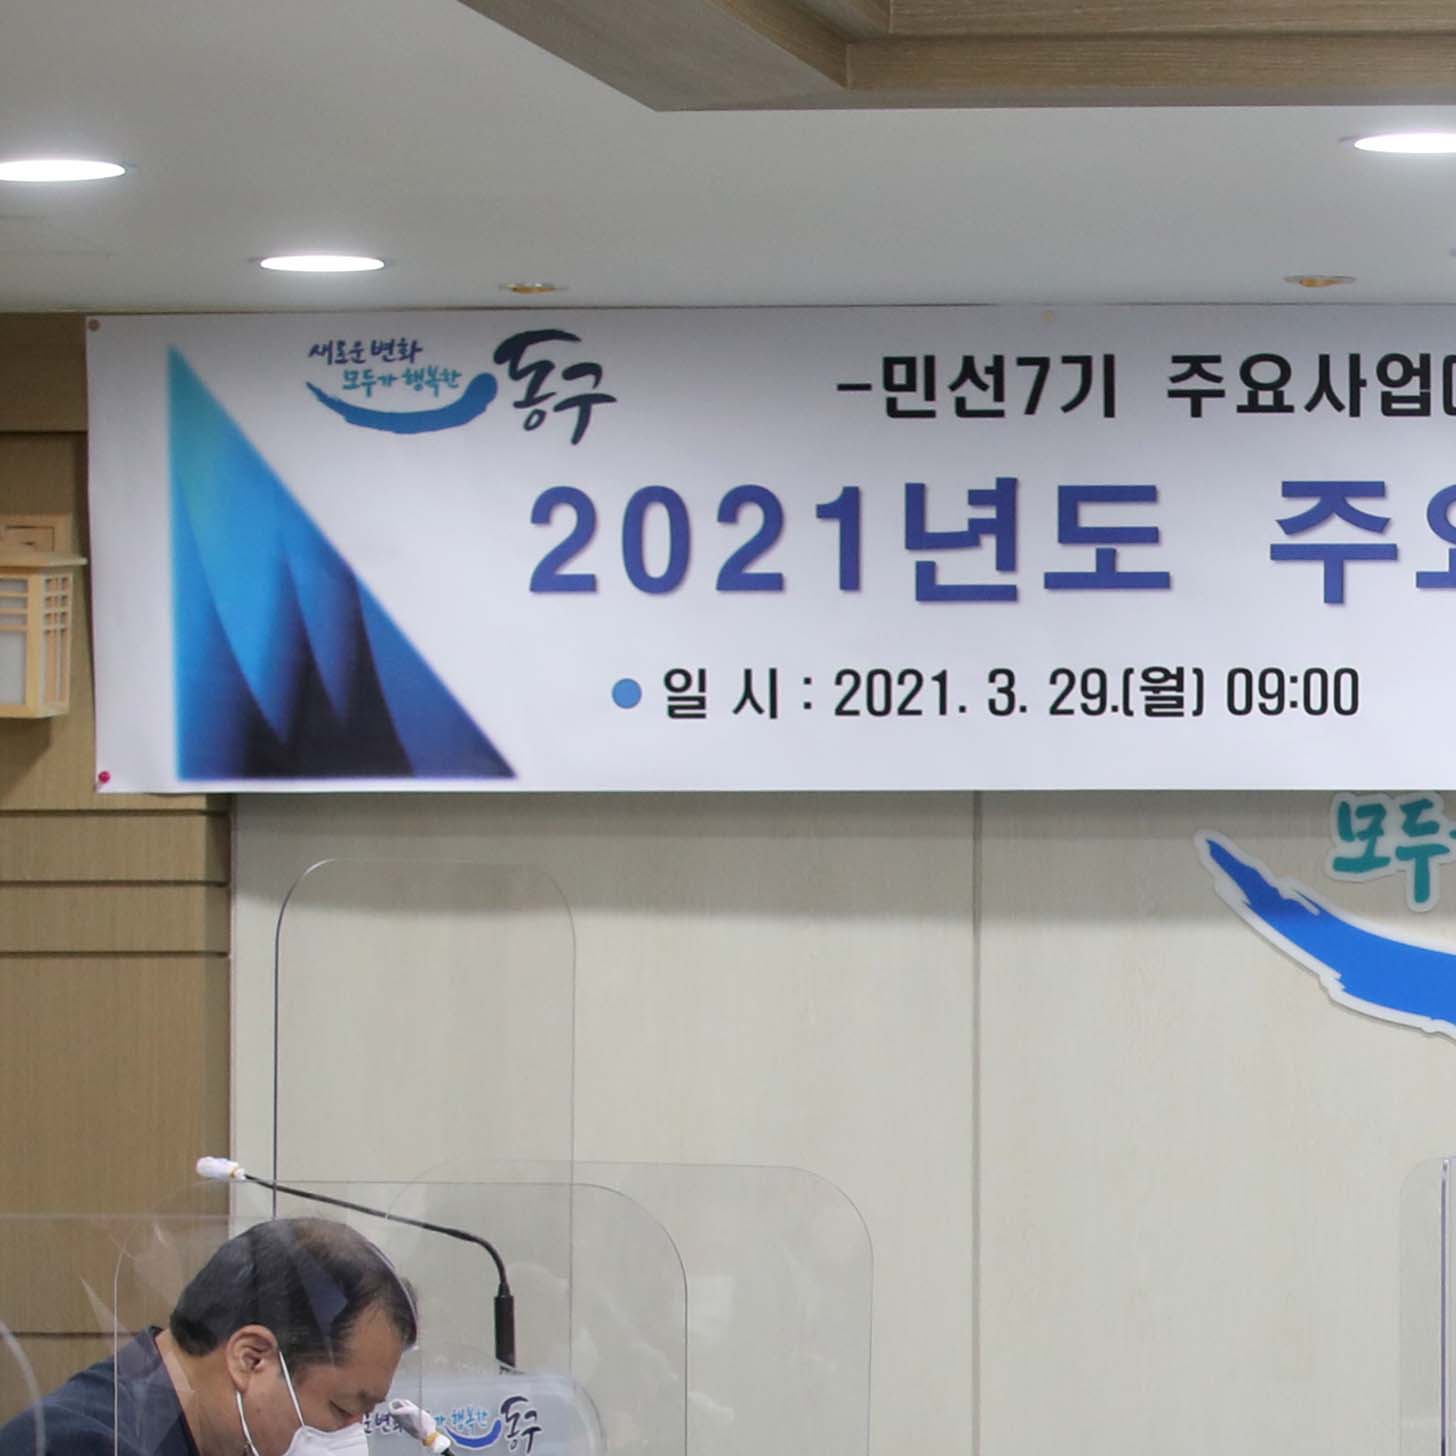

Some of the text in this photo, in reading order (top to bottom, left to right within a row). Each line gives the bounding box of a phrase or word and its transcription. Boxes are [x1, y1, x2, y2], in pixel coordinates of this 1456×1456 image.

[308, 338, 423, 366] 새로운 변화
[342, 365, 462, 398] 모두가 행복한
[493, 329, 617, 446] 동구
[837, 353, 1115, 418] -민선7기
[530, 477, 1171, 602] 2021년도
[835, 669, 966, 716] 2021.
[989, 669, 1026, 716] 3.
[1050, 667, 1203, 717] 29.(월)
[1228, 668, 1358, 715] 09:00
[500, 1395, 543, 1454] 동구
